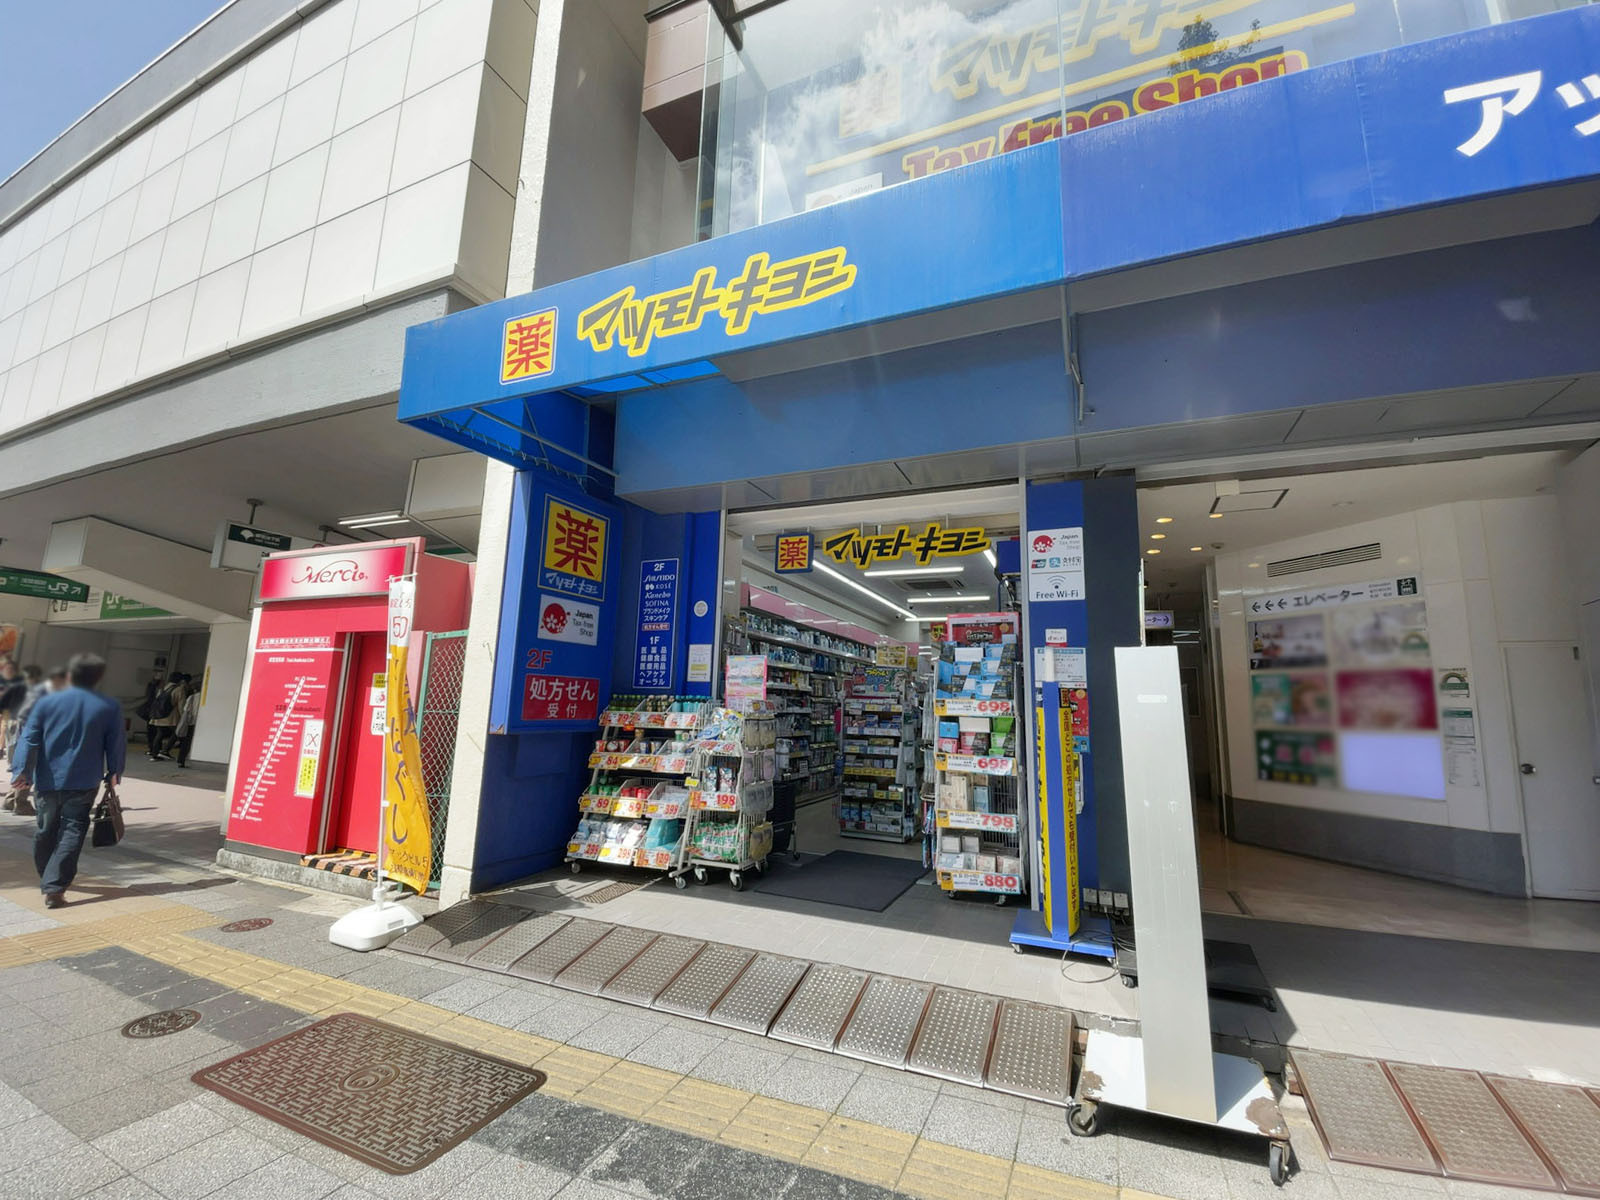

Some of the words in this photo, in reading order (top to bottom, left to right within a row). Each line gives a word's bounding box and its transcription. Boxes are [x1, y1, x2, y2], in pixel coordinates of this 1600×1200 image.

[506, 316, 552, 377] 薬
[577, 246, 857, 357] マツモトキヨシ
[554, 509, 599, 577] 薬
[779, 537, 807, 569] 薬
[823, 523, 992, 569] マツモトキヨシ
[291, 559, 359, 584] Merci
[654, 563, 665, 571] 2F
[48, 582, 69, 595] JR
[545, 572, 599, 594] マツモトキヨシ
[1036, 591, 1055, 599] Free
[1056, 589, 1079, 598] Wi-Fi
[1293, 590, 1364, 606] エレベーター
[575, 609, 594, 620] Japan
[579, 627, 593, 637] Shop
[650, 636, 660, 645] 1F
[526, 648, 553, 670] 2F
[529, 677, 596, 702] 処方せん
[546, 702, 577, 719] 受付
[977, 701, 1011, 713] 698
[716, 794, 736, 806] 198
[980, 814, 1015, 828] 798
[984, 874, 1018, 888] 880
